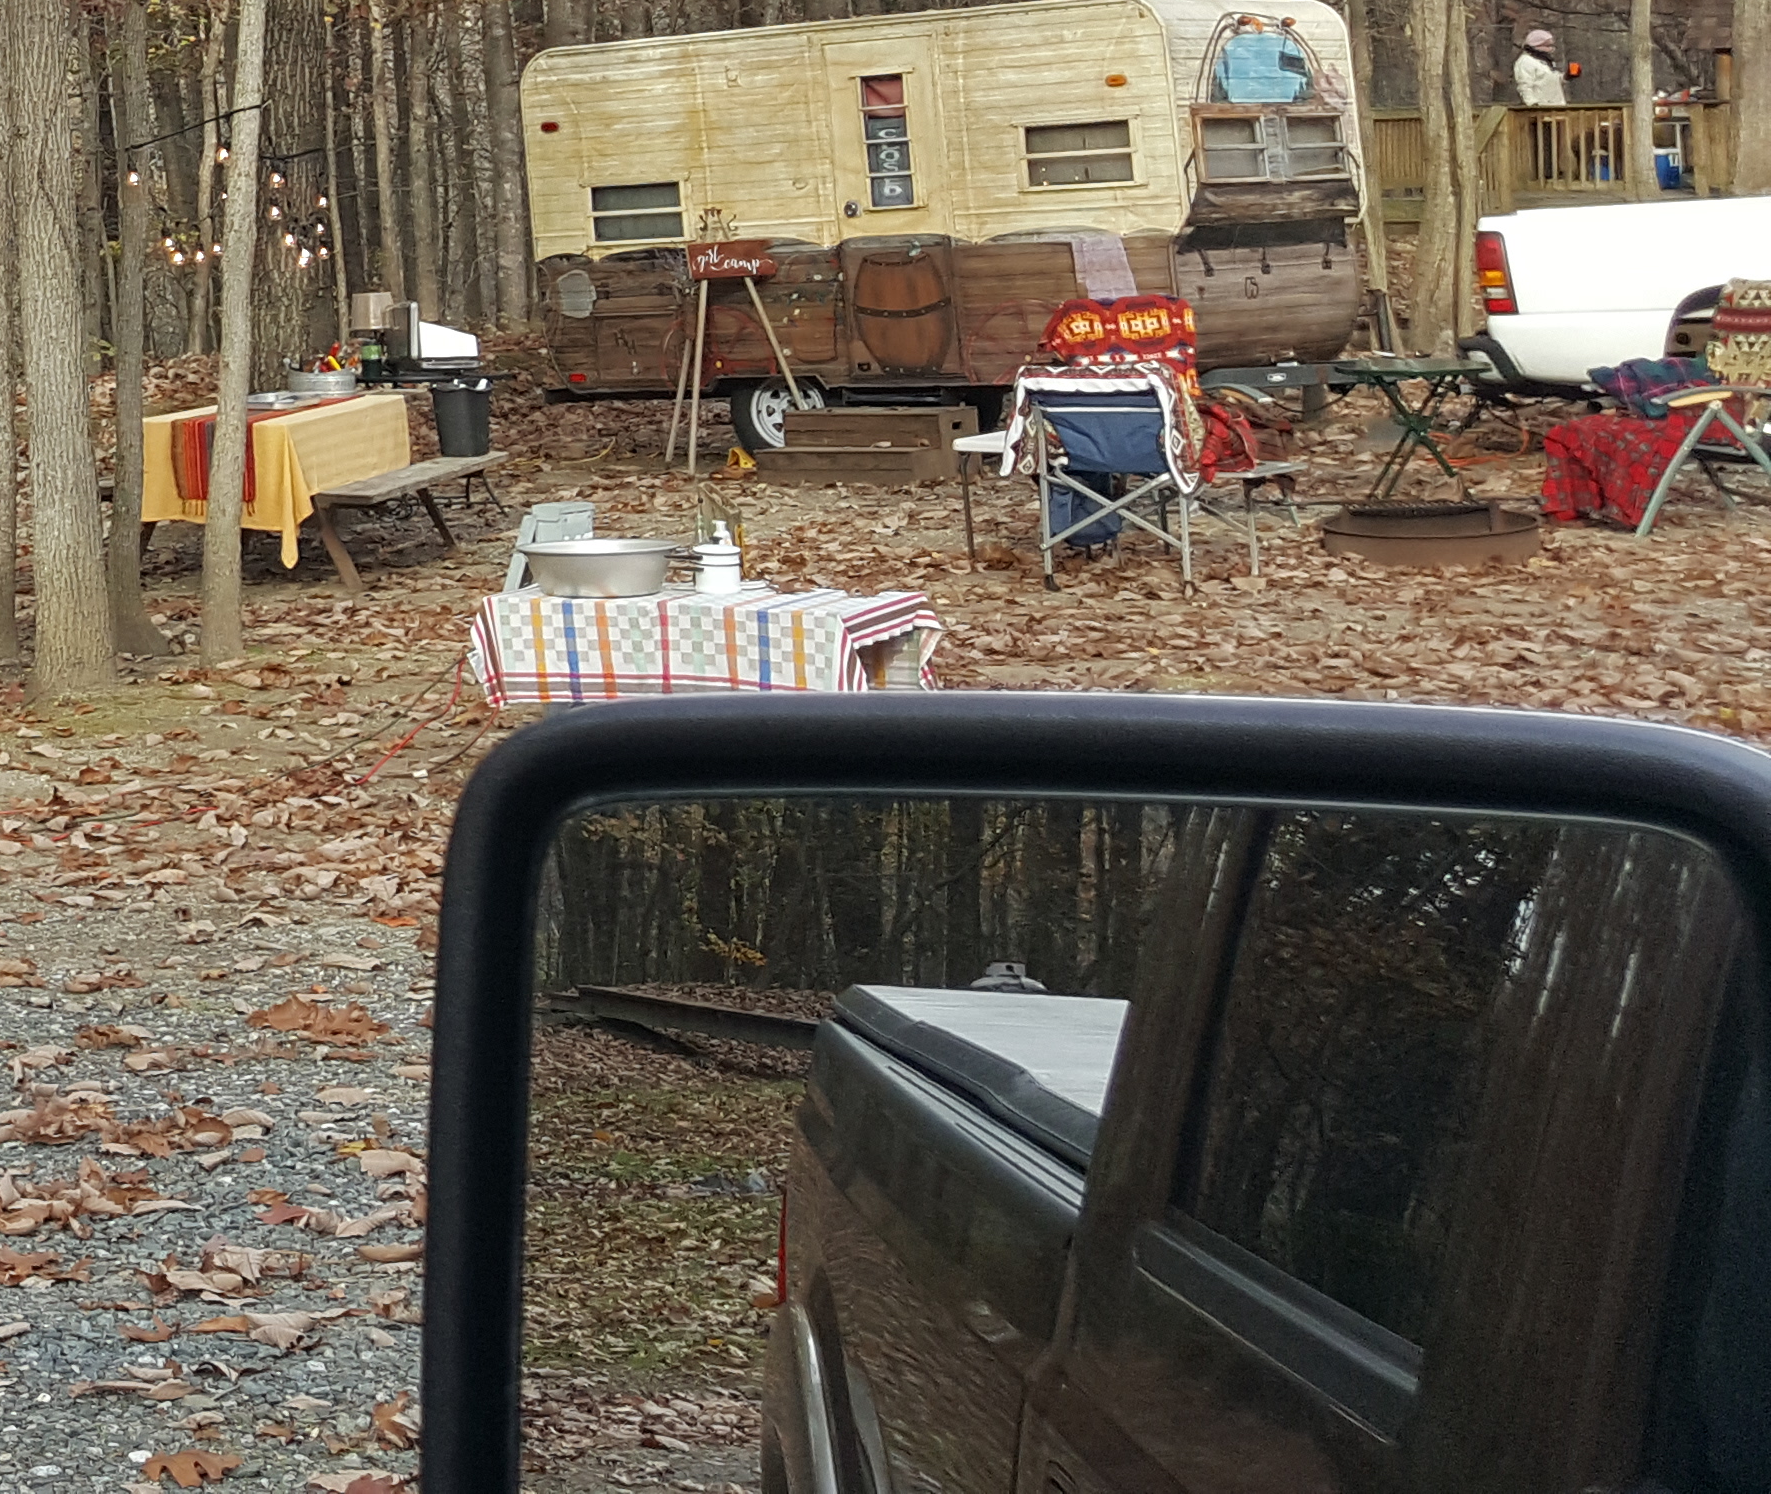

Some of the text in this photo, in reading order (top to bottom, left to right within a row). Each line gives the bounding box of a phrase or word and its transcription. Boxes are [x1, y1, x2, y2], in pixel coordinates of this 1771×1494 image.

[878, 128, 903, 197] COSED
[692, 244, 765, 275] girl camp
